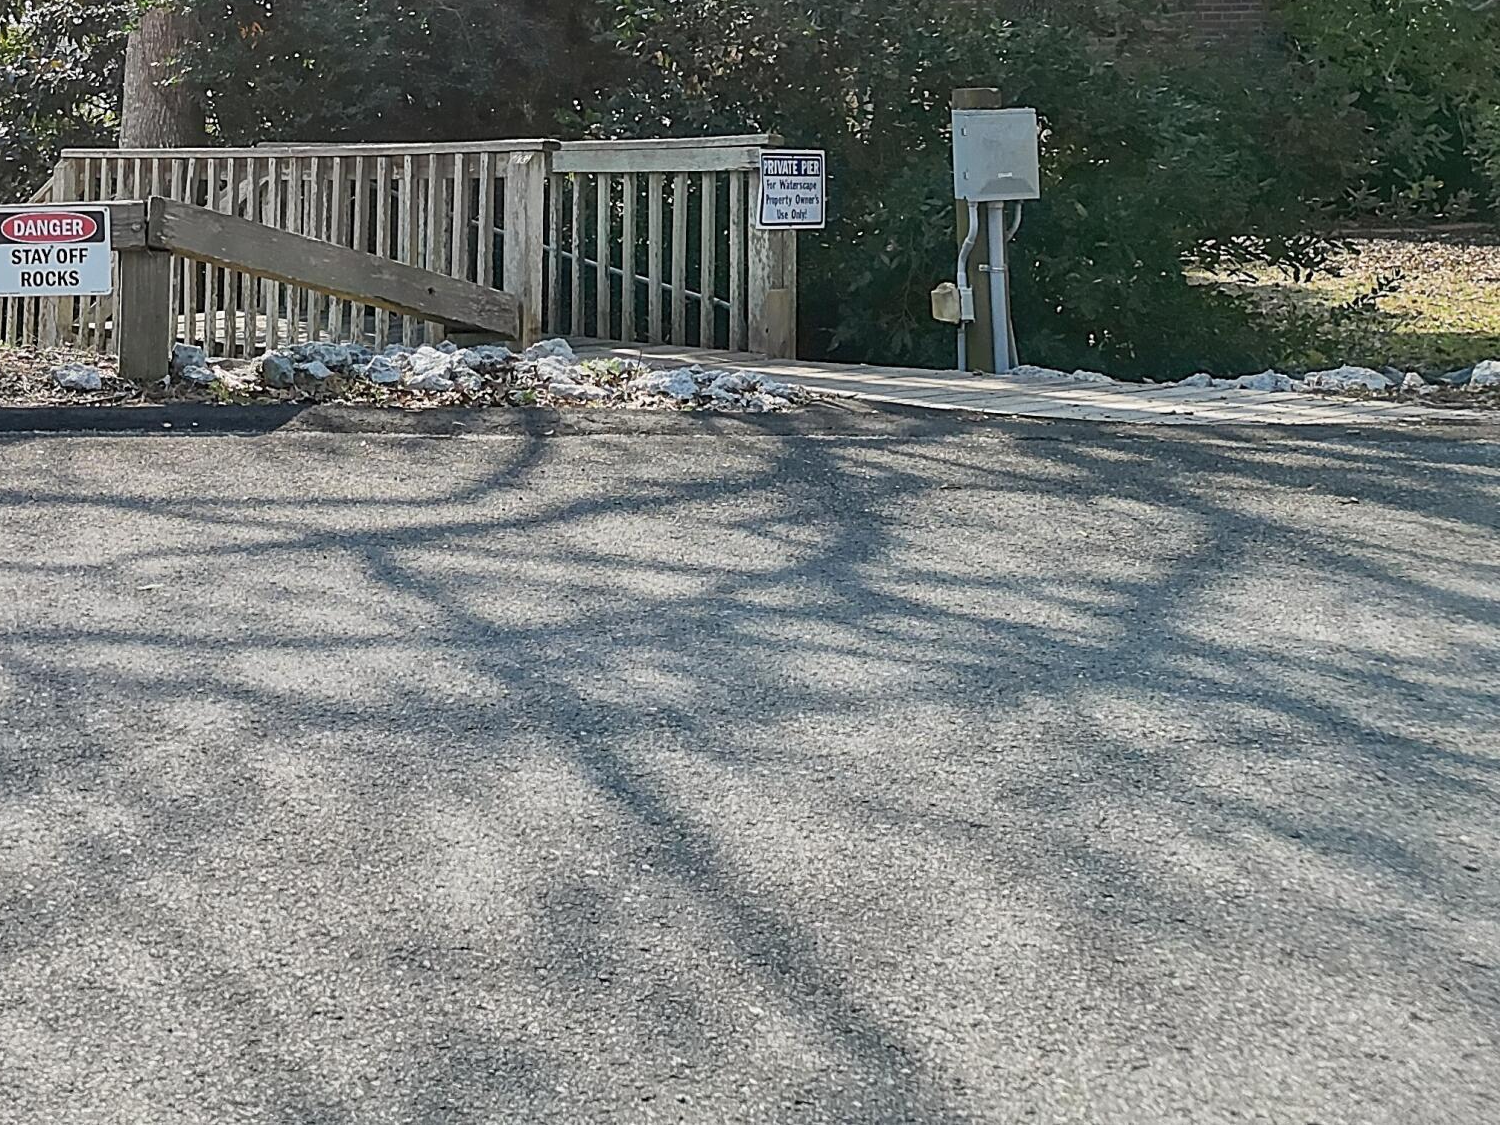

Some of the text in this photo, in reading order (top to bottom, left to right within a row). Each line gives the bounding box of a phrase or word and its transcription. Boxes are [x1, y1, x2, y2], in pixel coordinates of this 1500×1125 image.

[763, 159, 820, 175] PRIVATE PIER
[766, 179, 817, 192] For Waterscape
[766, 194, 819, 207] Property Owner's
[776, 209, 788, 220] Use
[13, 219, 84, 236] DANGER
[11, 247, 88, 265] STAY OFF
[21, 270, 80, 287] ROCKS
